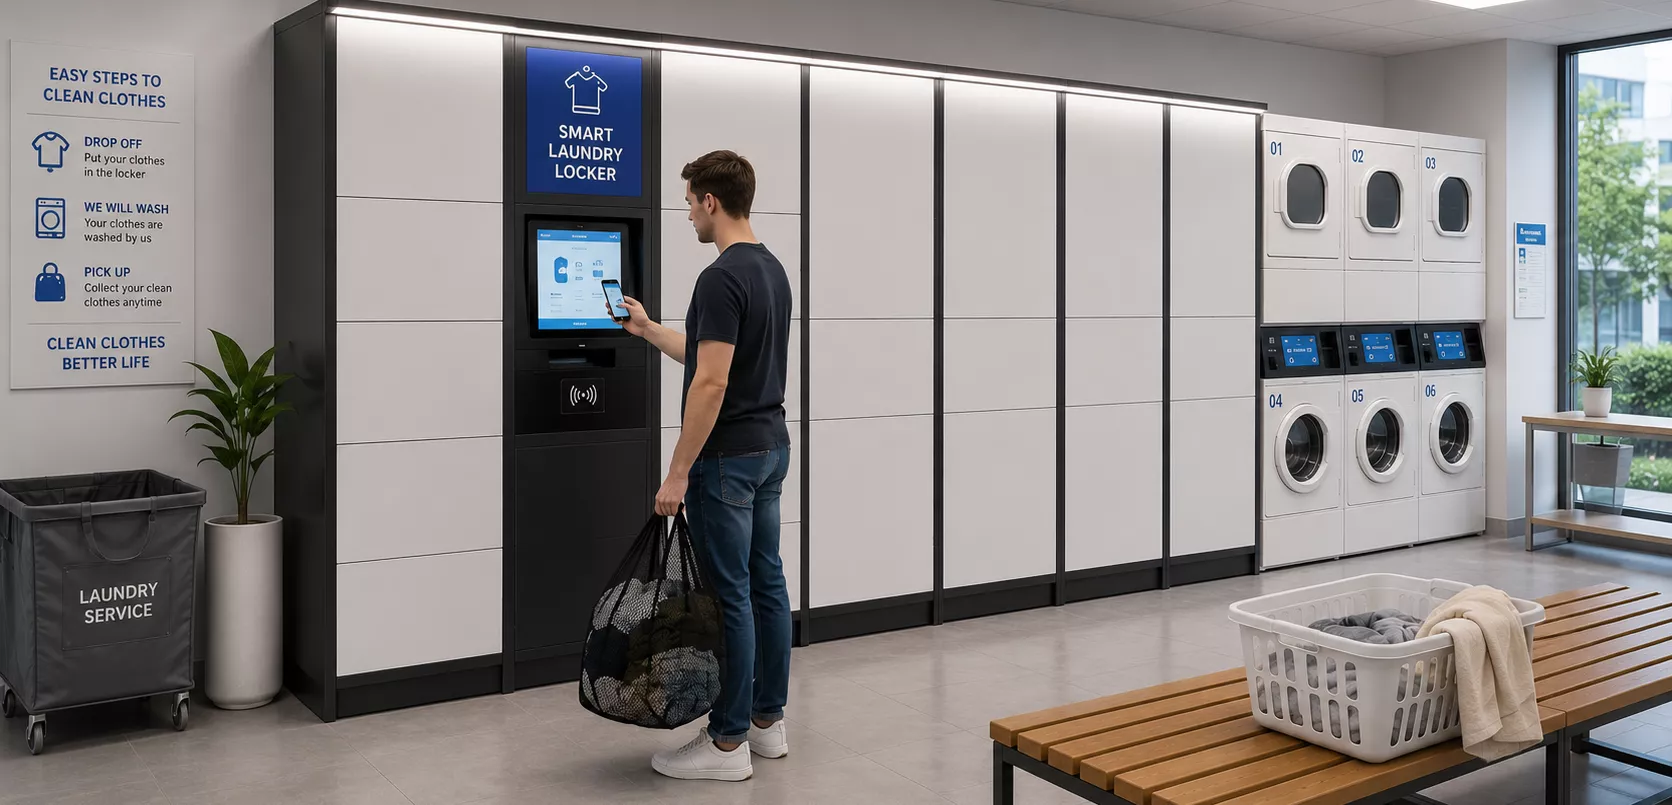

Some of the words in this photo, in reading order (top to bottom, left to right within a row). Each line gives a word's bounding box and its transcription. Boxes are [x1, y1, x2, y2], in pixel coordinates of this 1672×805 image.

[49, 67, 88, 82] EASY
[92, 71, 137, 85] STEPS
[141, 74, 161, 87] TO
[43, 88, 93, 103] CLEAN
[98, 92, 165, 108] CLOTHES
[559, 124, 613, 142] SMART
[84, 137, 117, 149] DROP
[120, 139, 142, 150] OFF
[1270, 141, 1282, 155] 01
[548, 143, 623, 161] LAUNDRY
[1351, 148, 1364, 162] 02
[84, 153, 101, 163] Put
[103, 156, 126, 166] your
[128, 155, 164, 166] clothes
[1425, 156, 1436, 169] 03
[84, 167, 93, 177] in
[95, 168, 112, 178] the
[115, 168, 145, 179] locker
[555, 164, 616, 181] LOCKER
[83, 202, 102, 213] WE
[105, 203, 133, 214] WILL
[135, 204, 168, 215] WASH
[84, 218, 107, 228] Your
[109, 219, 145, 229] clothes
[147, 222, 162, 230] are
[83, 233, 122, 243] washed
[125, 233, 137, 245] by
[140, 236, 151, 244] us
[84, 267, 111, 278] PICK
[114, 267, 130, 278] UP
[84, 283, 118, 293] Collect
[121, 285, 144, 295] your
[146, 283, 172, 293] clean
[83, 297, 120, 308] clothes
[122, 297, 162, 309] anytime
[46, 337, 95, 350] CLEAN
[100, 336, 165, 349] CLOTHES
[62, 357, 117, 369] BETTER
[121, 356, 149, 368] LIFE
[1351, 388, 1364, 402] 05
[1425, 384, 1436, 397] 06
[1269, 393, 1283, 408] 04
[80, 581, 158, 605] LAUNDRY
[84, 603, 152, 623] SERVICE
